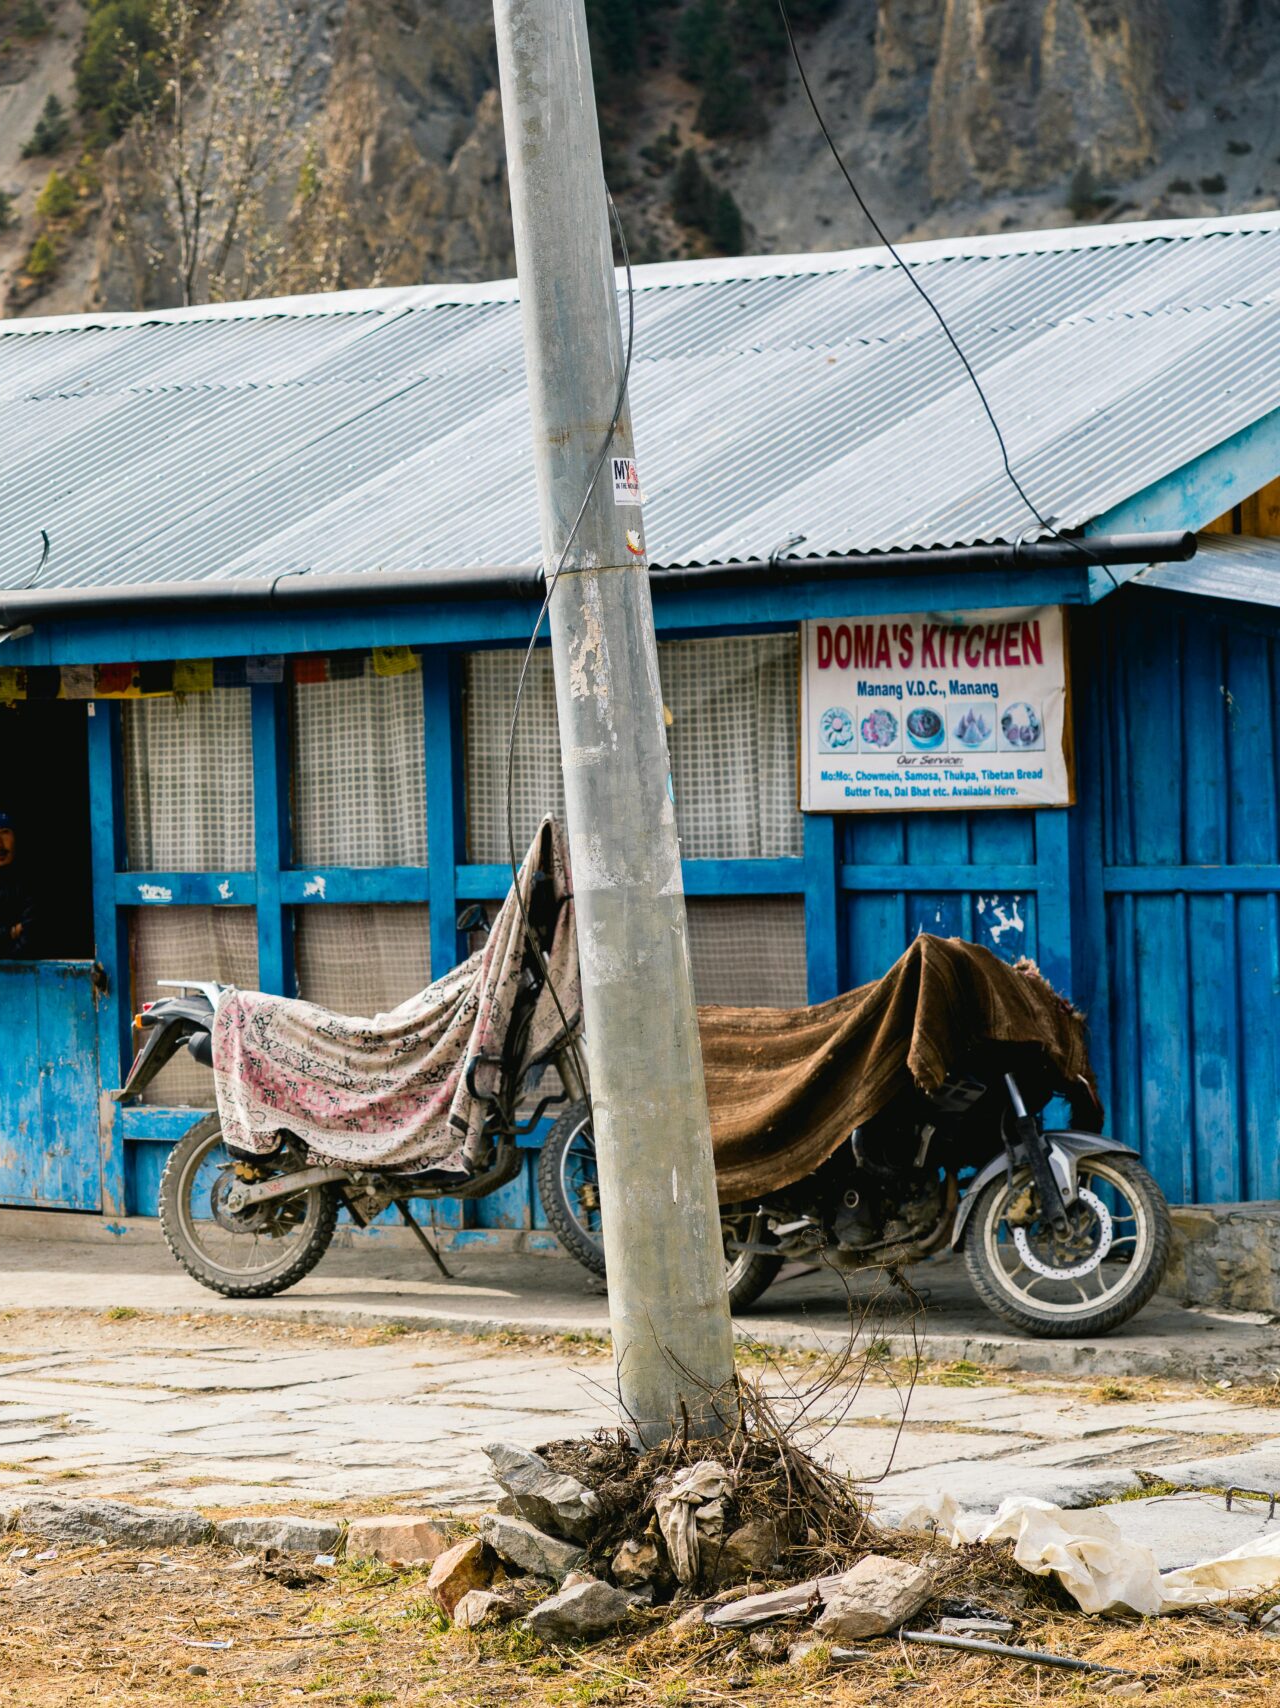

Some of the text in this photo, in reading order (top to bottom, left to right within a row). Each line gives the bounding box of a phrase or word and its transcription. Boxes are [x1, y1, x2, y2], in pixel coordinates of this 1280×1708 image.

[817, 620, 1044, 670] DOMA'S KITCHEN
[857, 679, 1000, 700] Manang V.D.C., Manang
[896, 755, 964, 765] Our Service:
[855, 770, 902, 782] Chowmein,
[904, 770, 941, 782] Samosa,
[943, 769, 979, 782] Thukpa,
[981, 769, 1015, 780] Tibetan
[1016, 767, 1043, 780] Bread
[844, 785, 1019, 798] Butter Tea, Dal Bhat etc. Available Here.
